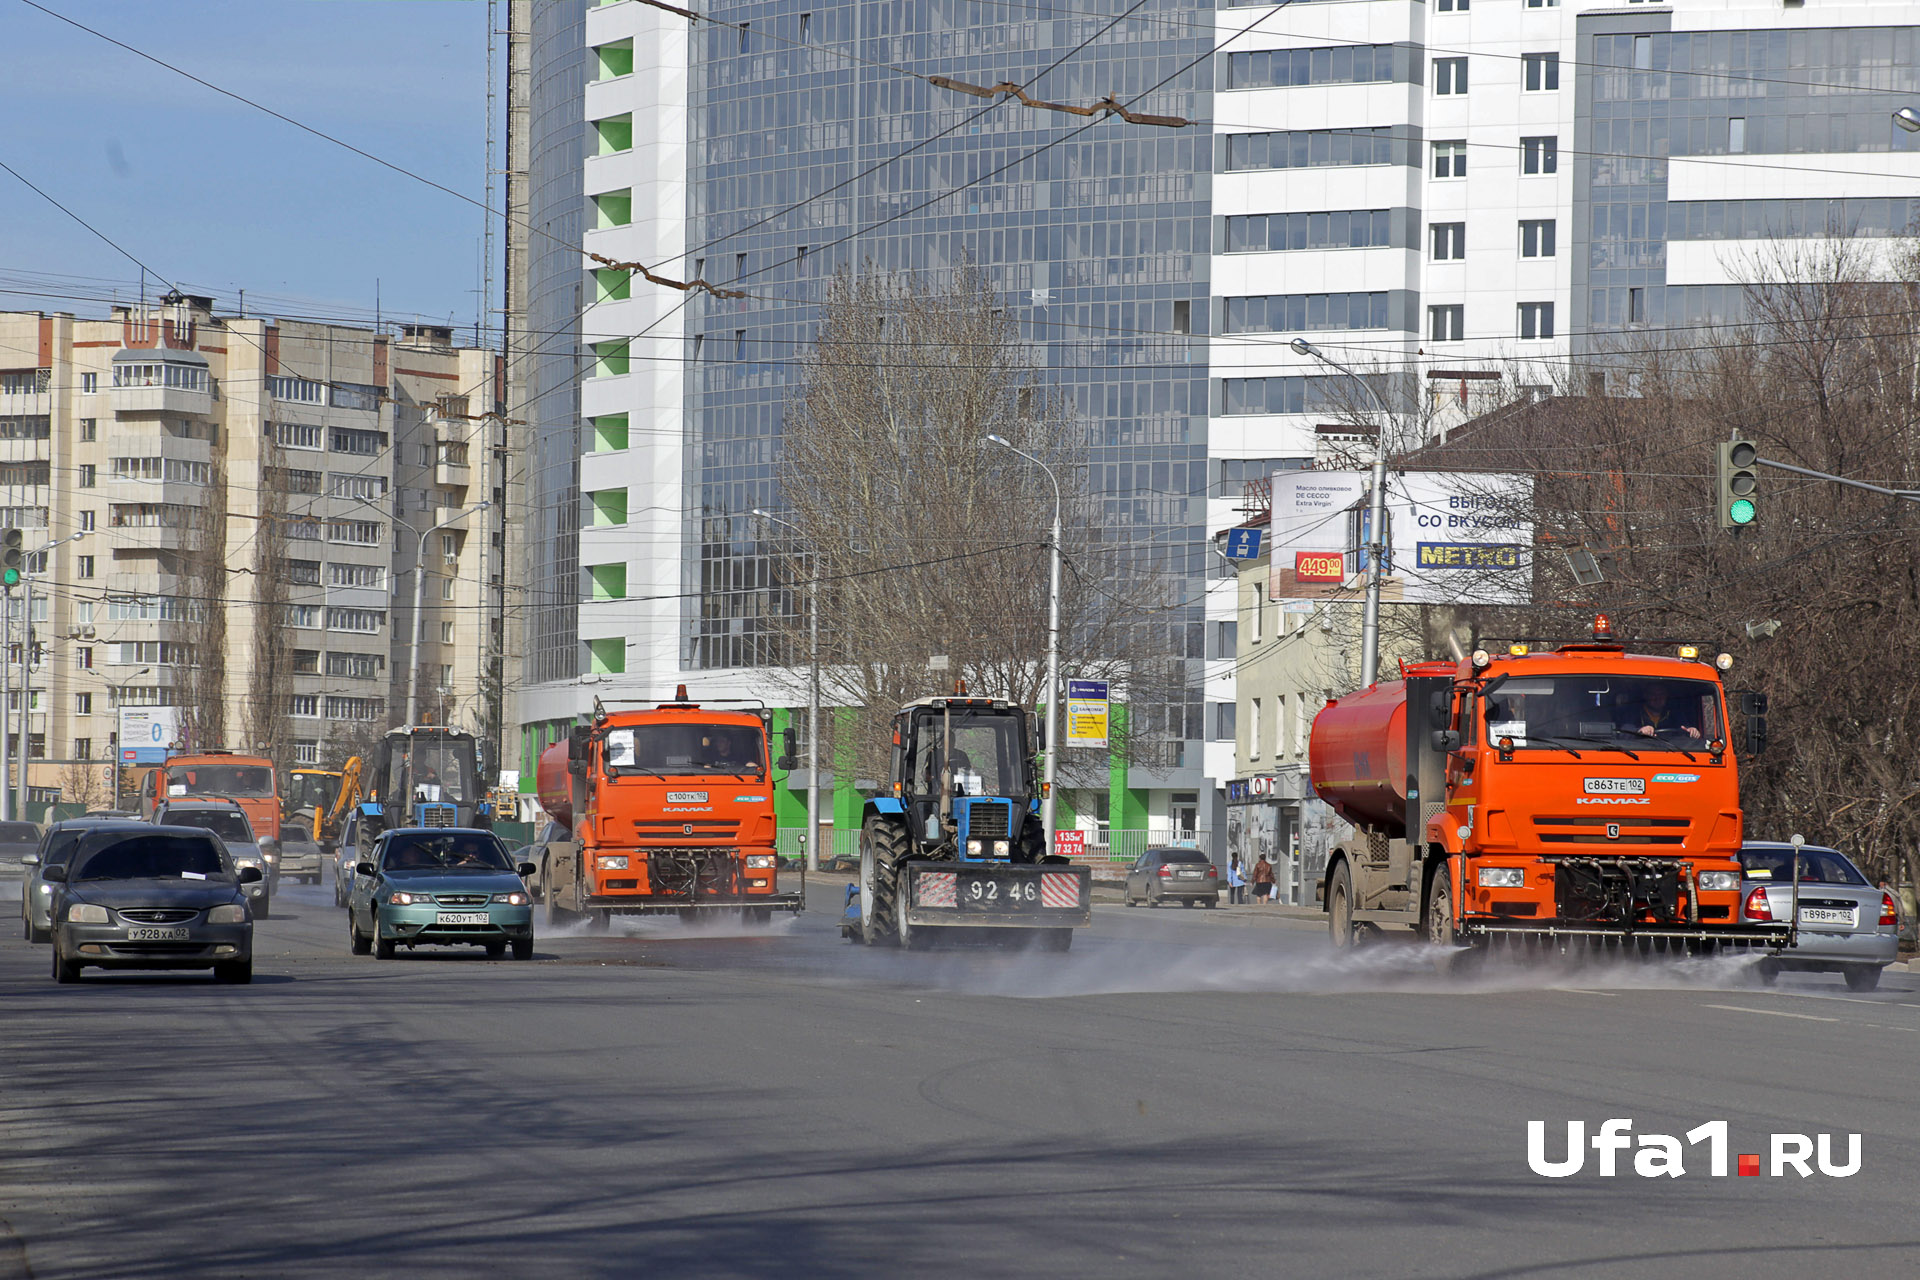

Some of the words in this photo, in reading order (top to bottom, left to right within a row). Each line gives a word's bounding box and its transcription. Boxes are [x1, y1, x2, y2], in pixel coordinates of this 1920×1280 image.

[1418, 515, 1442, 527] СО
[1448, 515, 1521, 528] ВКУСОМ
[1421, 546, 1516, 565] METRO
[1300, 558, 1329, 576] 449
[1329, 559, 1341, 569] 00
[1587, 780, 1626, 790] С863ТЕ
[1628, 780, 1643, 788] 102
[1063, 844, 1072, 853] 32
[1073, 844, 1082, 853] 74
[971, 881, 998, 900] 92
[1010, 882, 1036, 901] 46
[1804, 910, 1837, 919] Т898РР
[1839, 911, 1851, 919] 102
[133, 929, 174, 939] У928ХА
